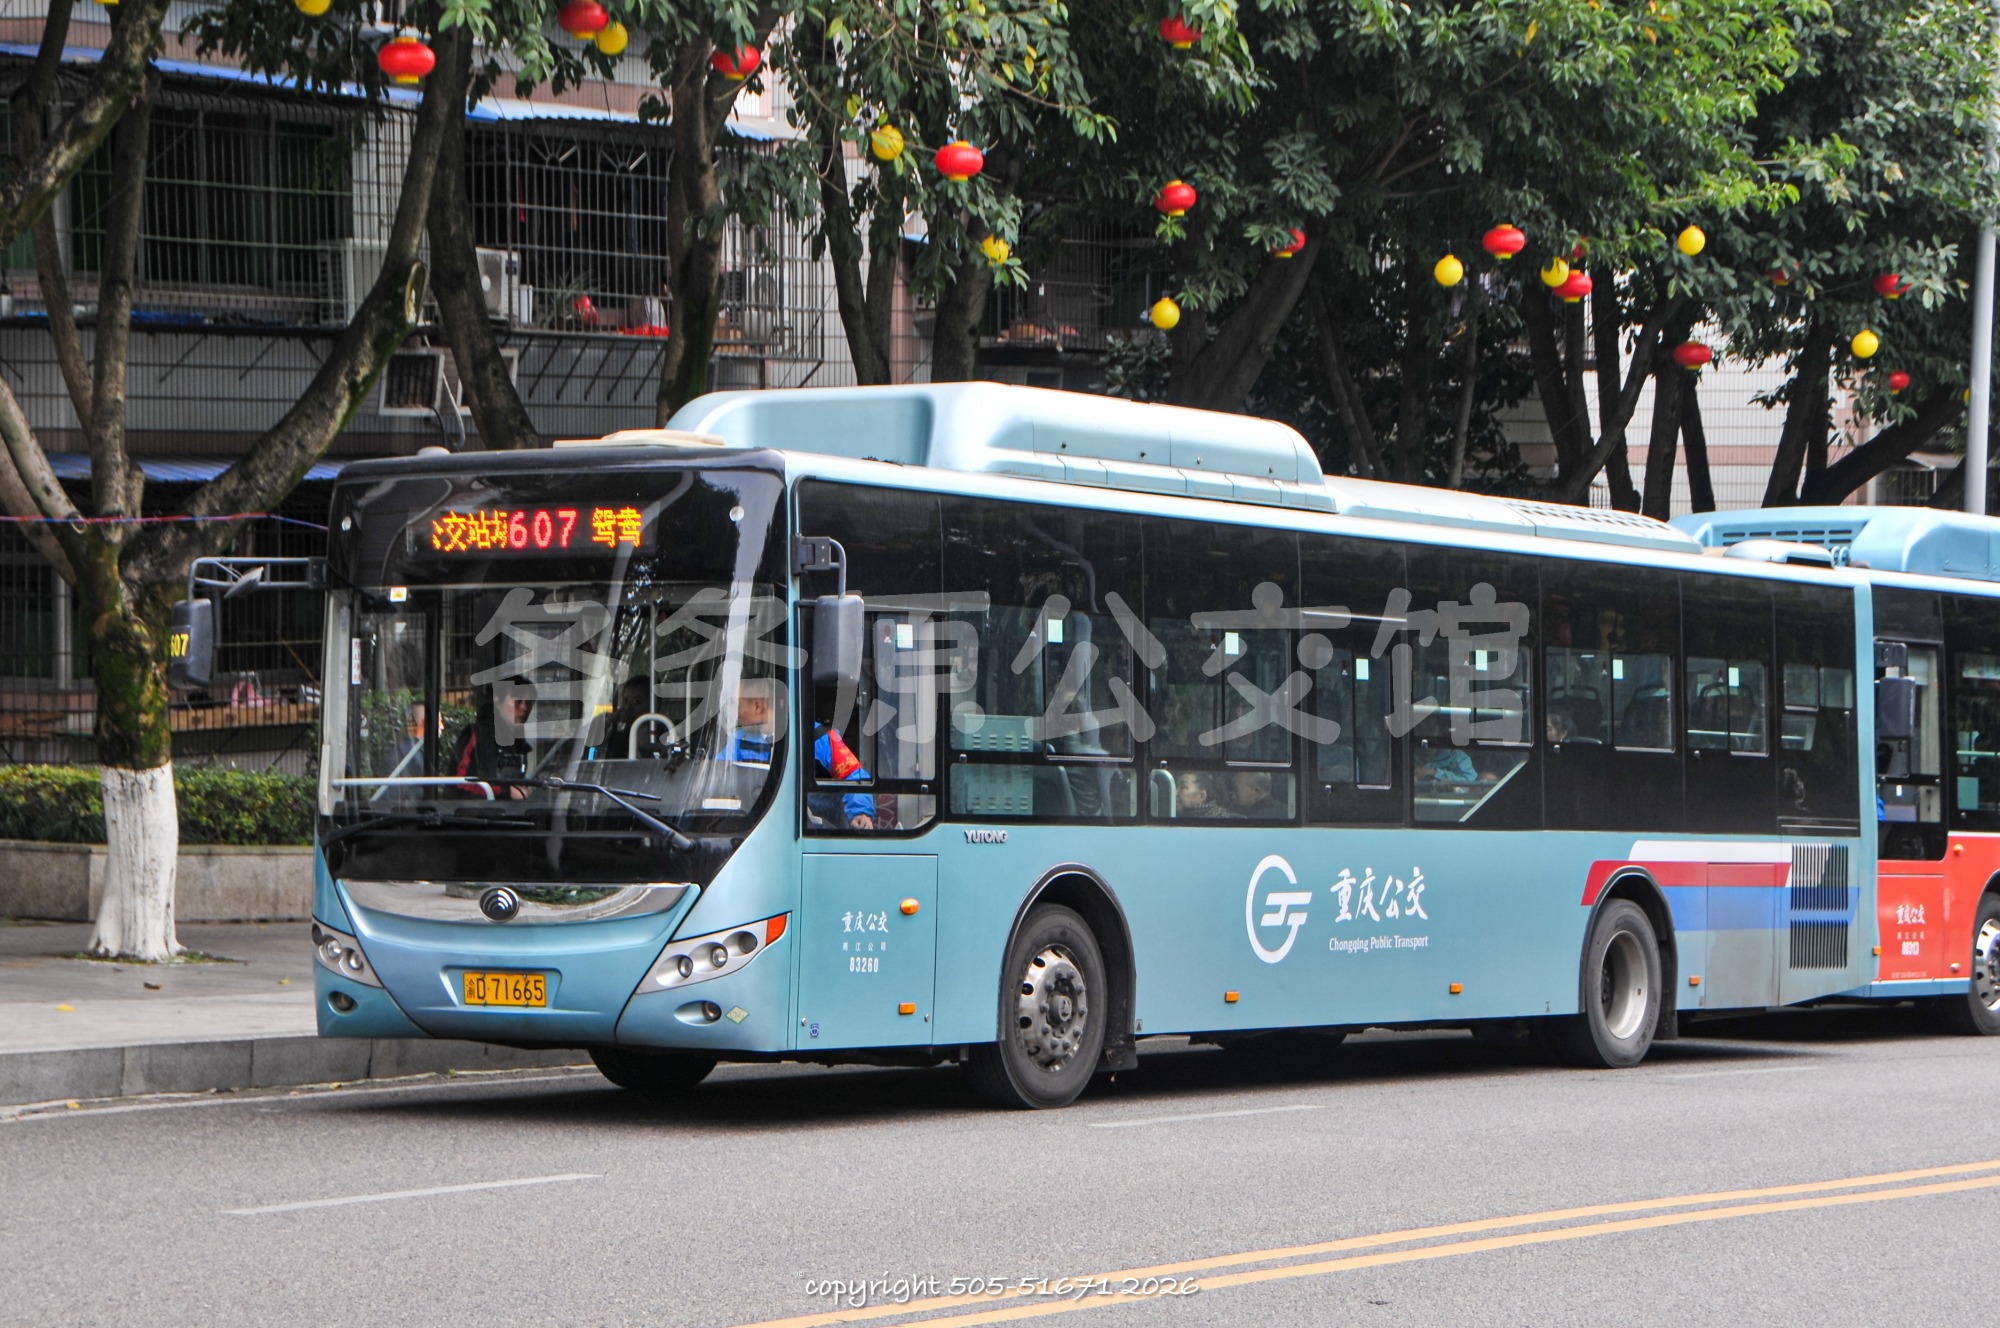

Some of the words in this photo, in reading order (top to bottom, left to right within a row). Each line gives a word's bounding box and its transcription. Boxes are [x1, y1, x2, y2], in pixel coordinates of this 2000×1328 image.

[509, 508, 578, 548] 607
[592, 507, 641, 548] 鸳鸯
[964, 829, 1009, 844] YUTONG
[1330, 865, 1429, 922] 重庆公交
[841, 910, 889, 933] 重庆公交
[1329, 937, 1369, 954] Chongqing
[1370, 936, 1392, 949] Public
[1394, 934, 1429, 950] Transport
[849, 956, 879, 973] 83260
